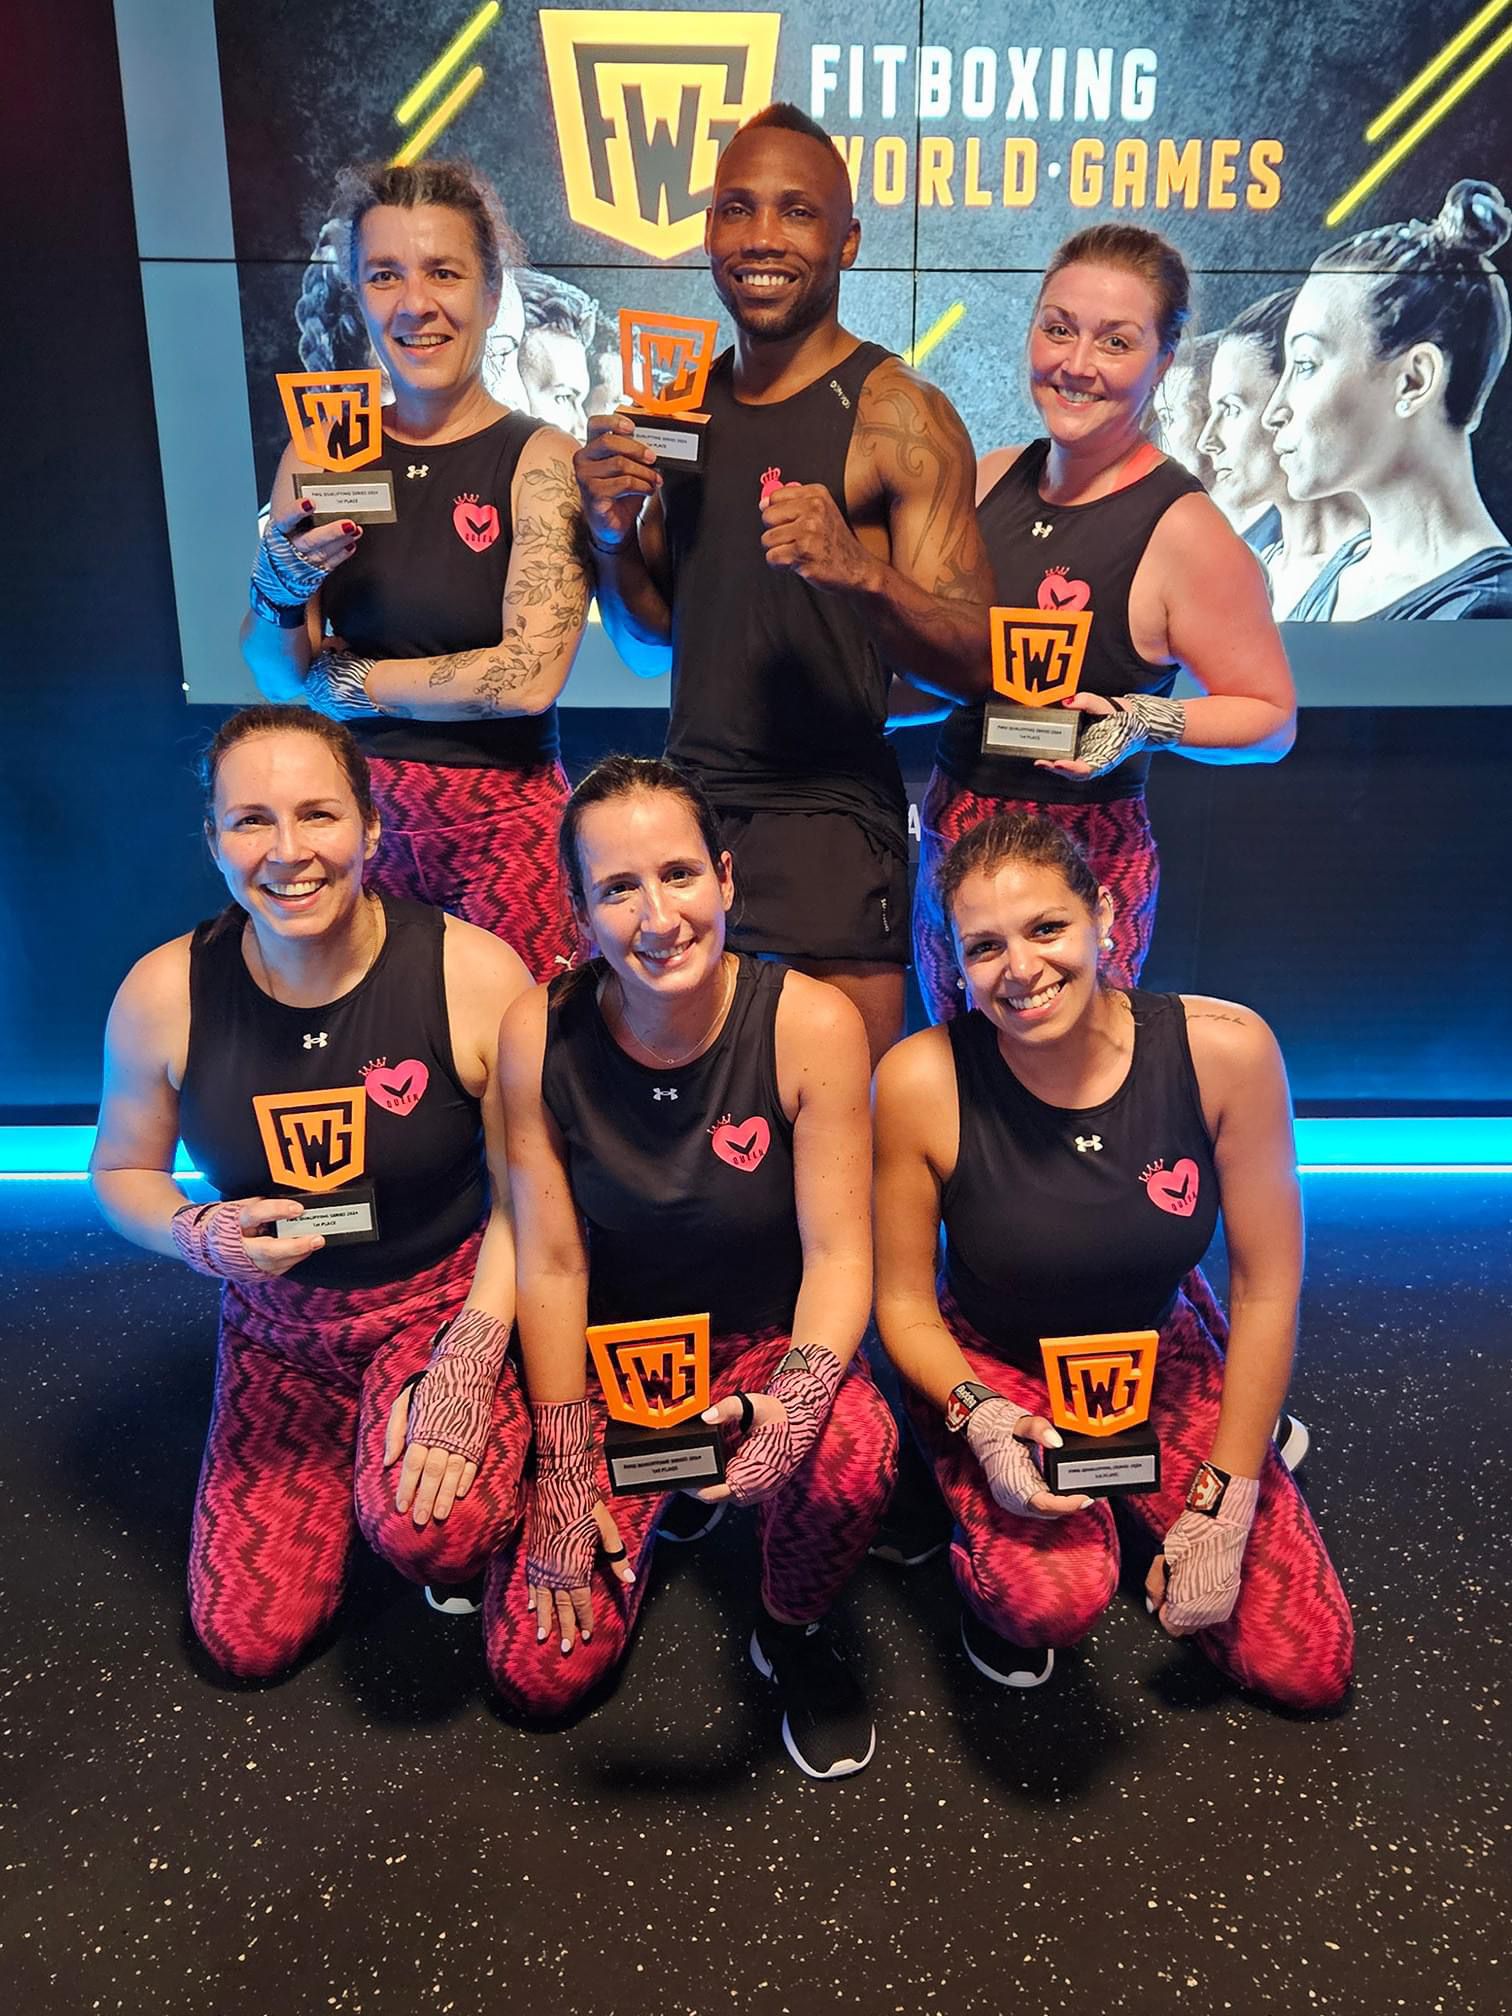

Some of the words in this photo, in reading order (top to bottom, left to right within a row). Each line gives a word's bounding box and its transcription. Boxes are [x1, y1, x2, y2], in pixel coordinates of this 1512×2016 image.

[810, 44, 1158, 121] FITBOXING
[1069, 138, 1284, 209] GAMES
[386, 1093, 420, 1108] QUEEN
